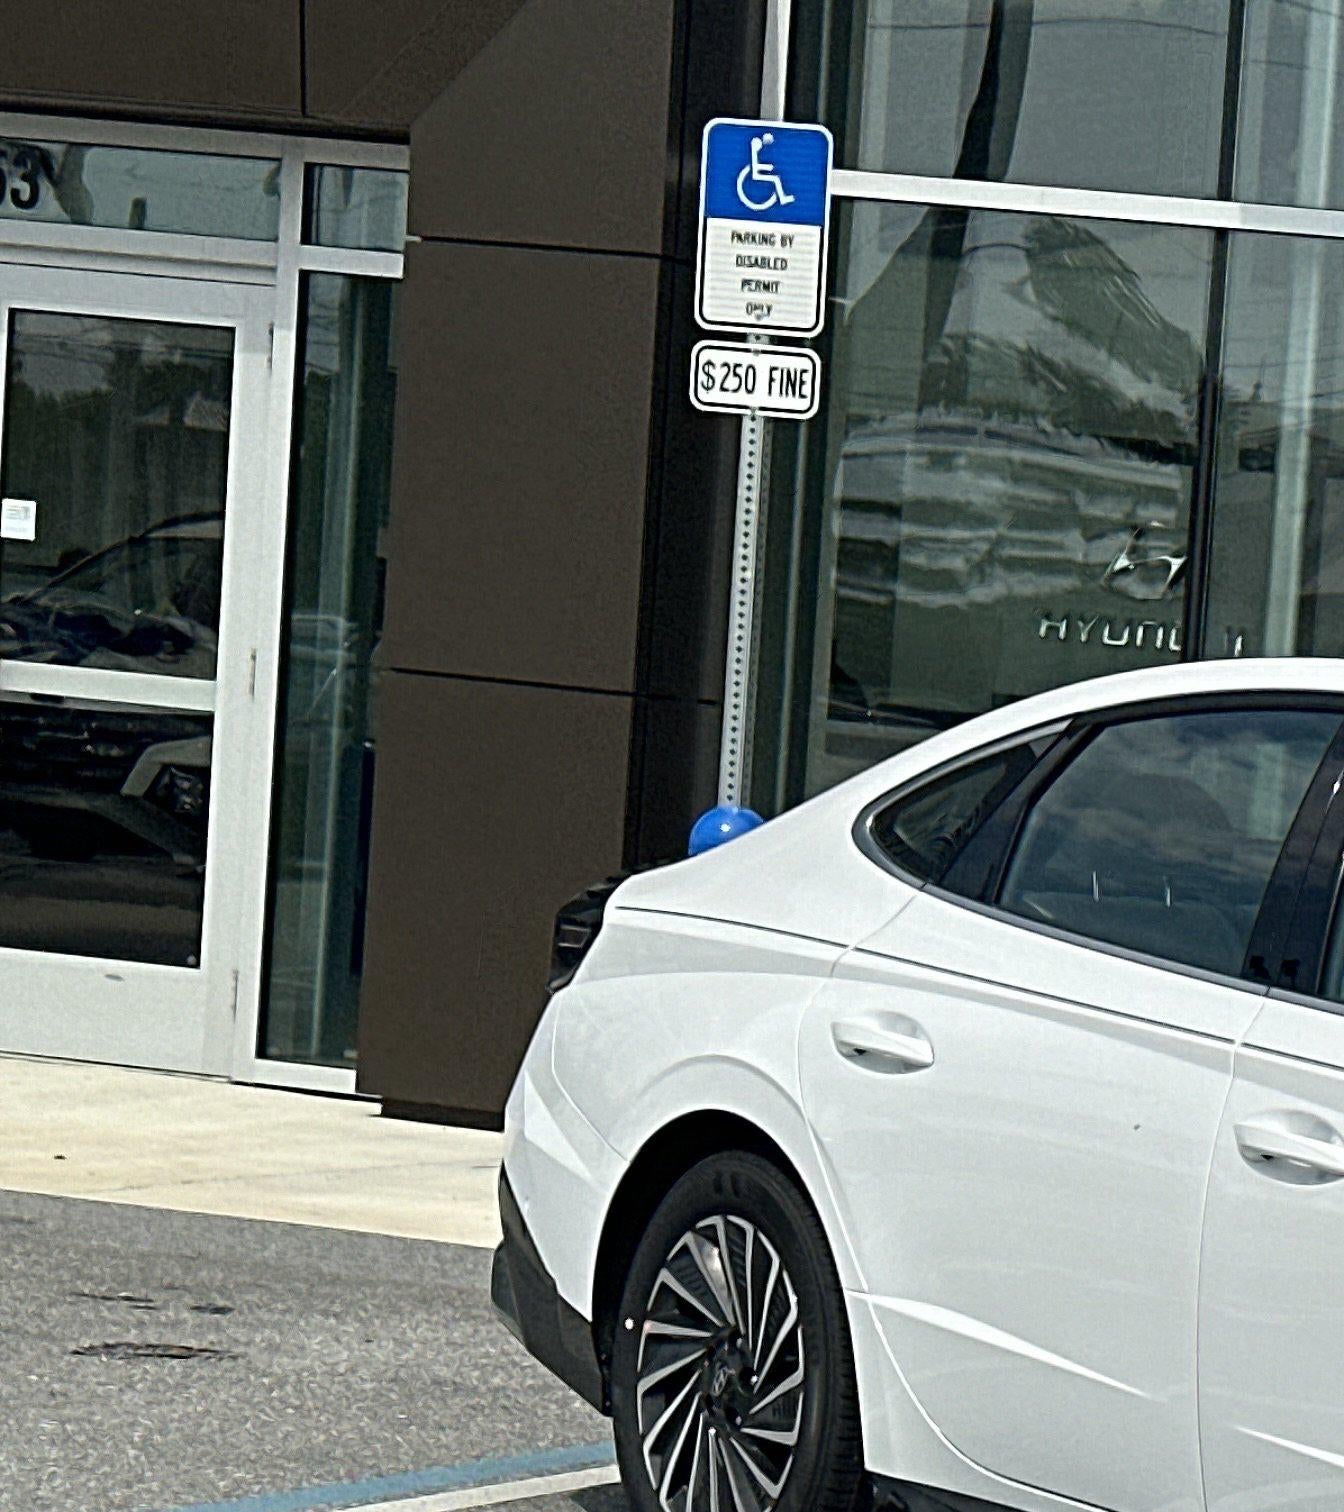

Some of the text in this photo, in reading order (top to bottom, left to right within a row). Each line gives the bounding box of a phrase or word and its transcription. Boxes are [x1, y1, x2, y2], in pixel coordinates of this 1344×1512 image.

[731, 230, 794, 248] PARKING BY
[736, 254, 788, 271] DISABLED
[741, 278, 780, 294] PERMIT
[701, 359, 809, 399] $250 FINE
